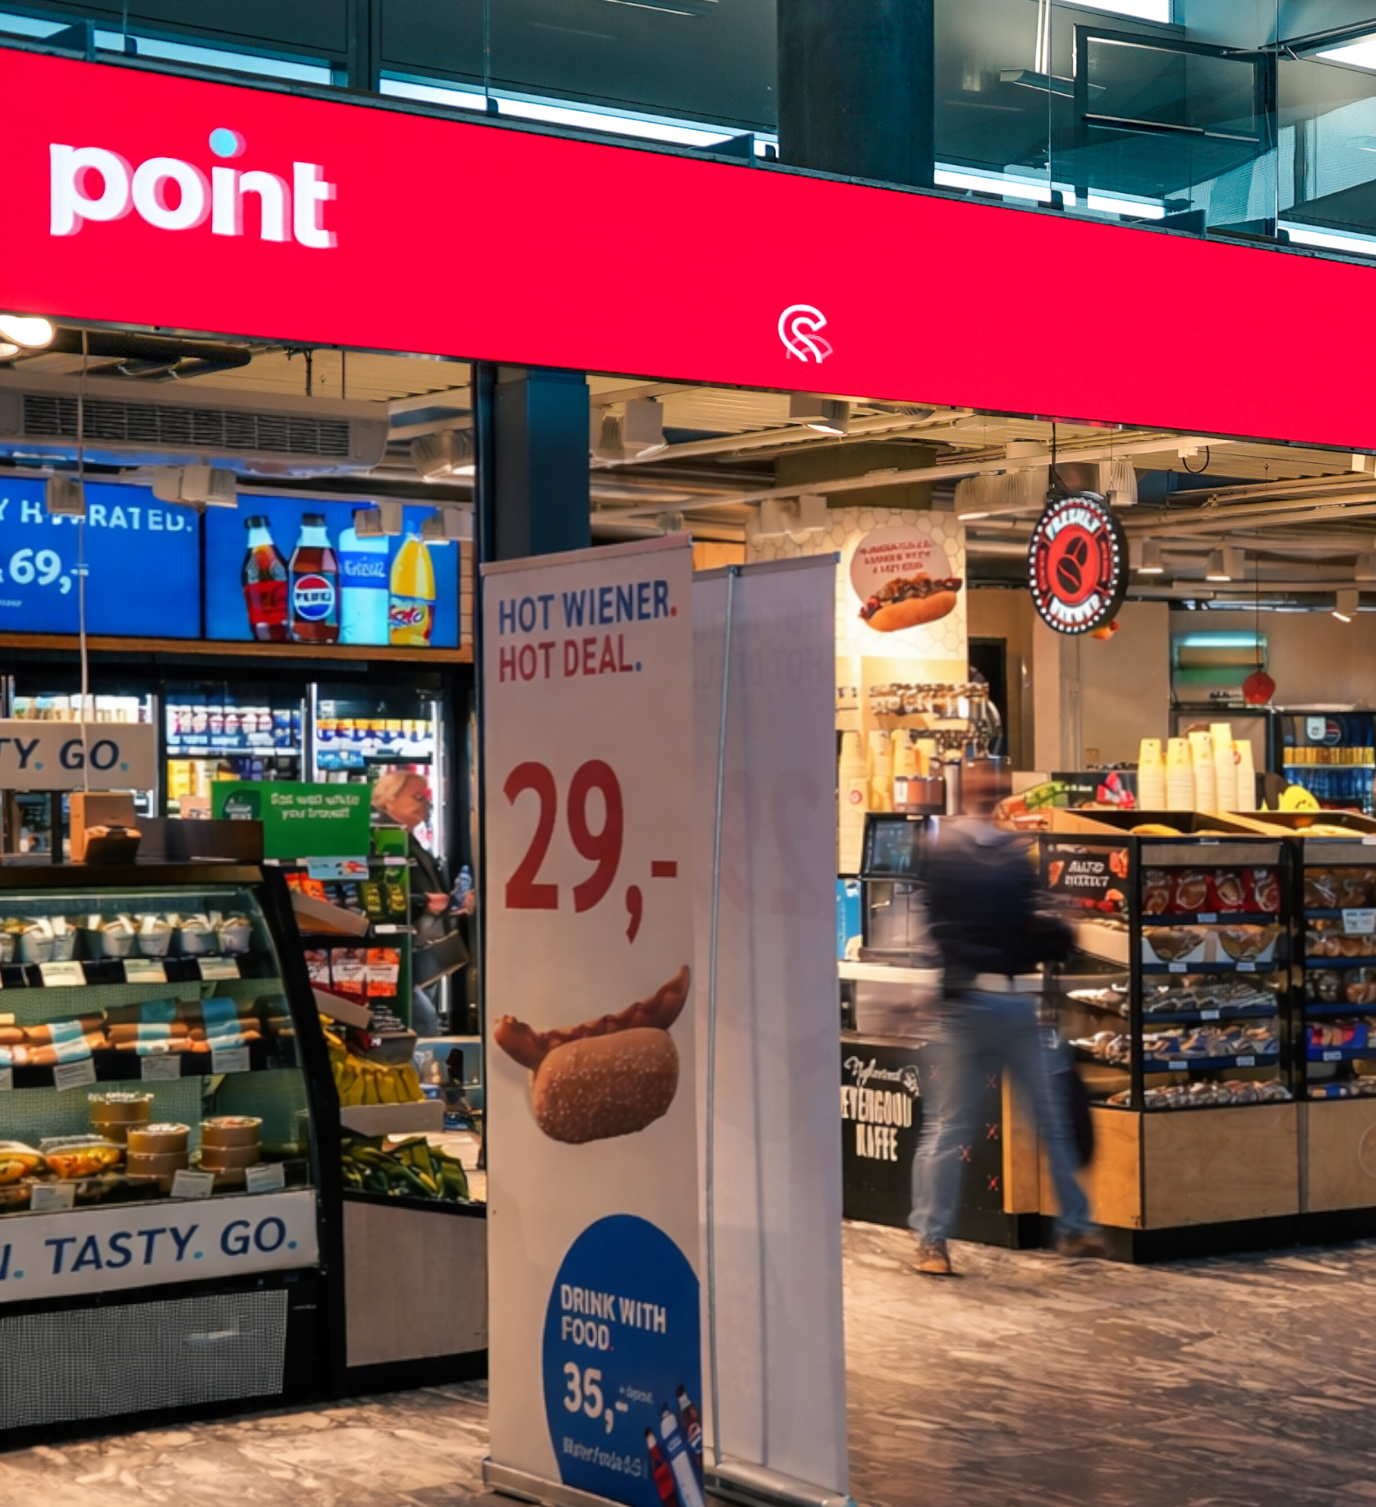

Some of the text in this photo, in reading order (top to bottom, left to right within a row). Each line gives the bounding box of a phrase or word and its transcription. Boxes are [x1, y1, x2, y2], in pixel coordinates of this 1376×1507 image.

[50, 128, 337, 249] point
[20, 499, 193, 533] HRATED.
[499, 580, 677, 635] HOT WIENER.
[499, 633, 642, 682] HOT DEAL.
[59, 738, 129, 772] GO.
[503, 759, 678, 943] 29,-
[44, 1224, 204, 1275] TASTY.
[220, 1216, 298, 1257] GO.
[561, 1284, 666, 1334] DRINK WITH
[563, 1361, 629, 1434] 35,-
